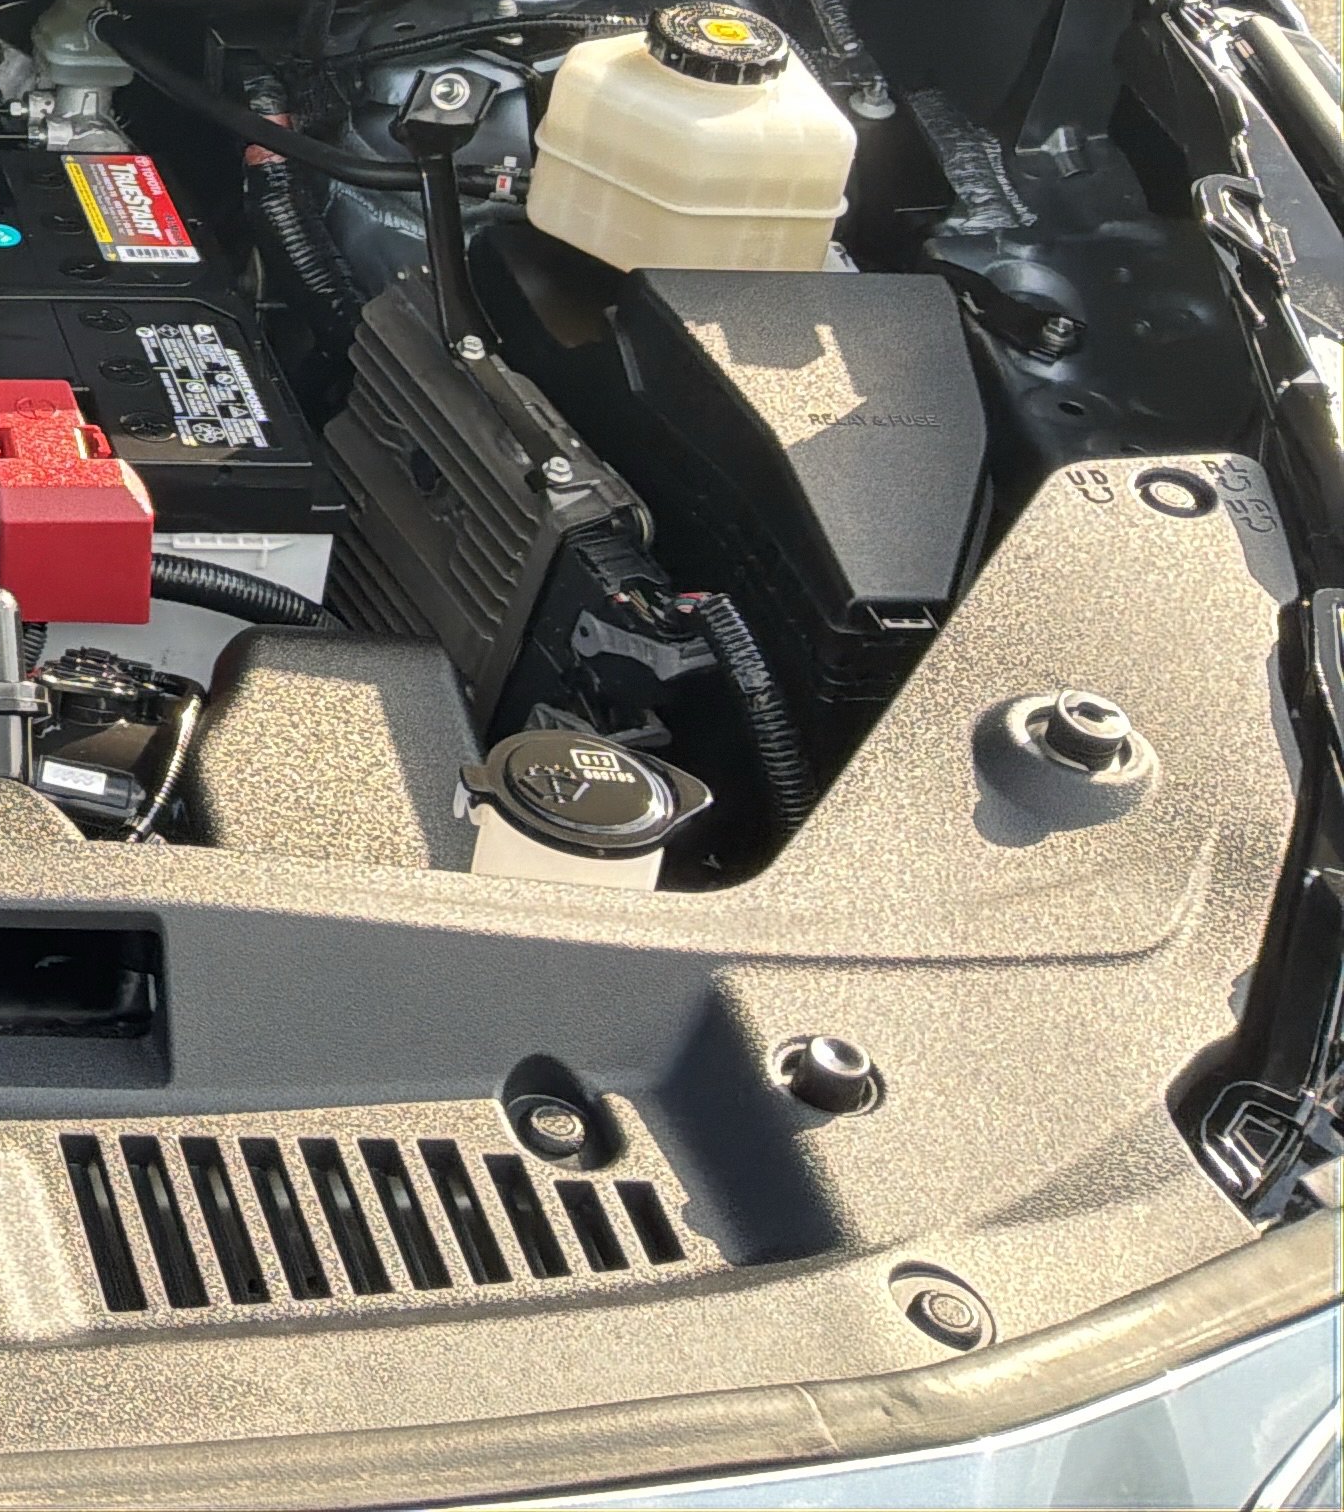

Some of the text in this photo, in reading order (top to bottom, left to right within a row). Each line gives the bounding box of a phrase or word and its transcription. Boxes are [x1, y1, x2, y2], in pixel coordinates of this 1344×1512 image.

[140, 167, 164, 196] TOYOTA
[807, 412, 868, 427] RELAY
[888, 412, 942, 428] FUSE
